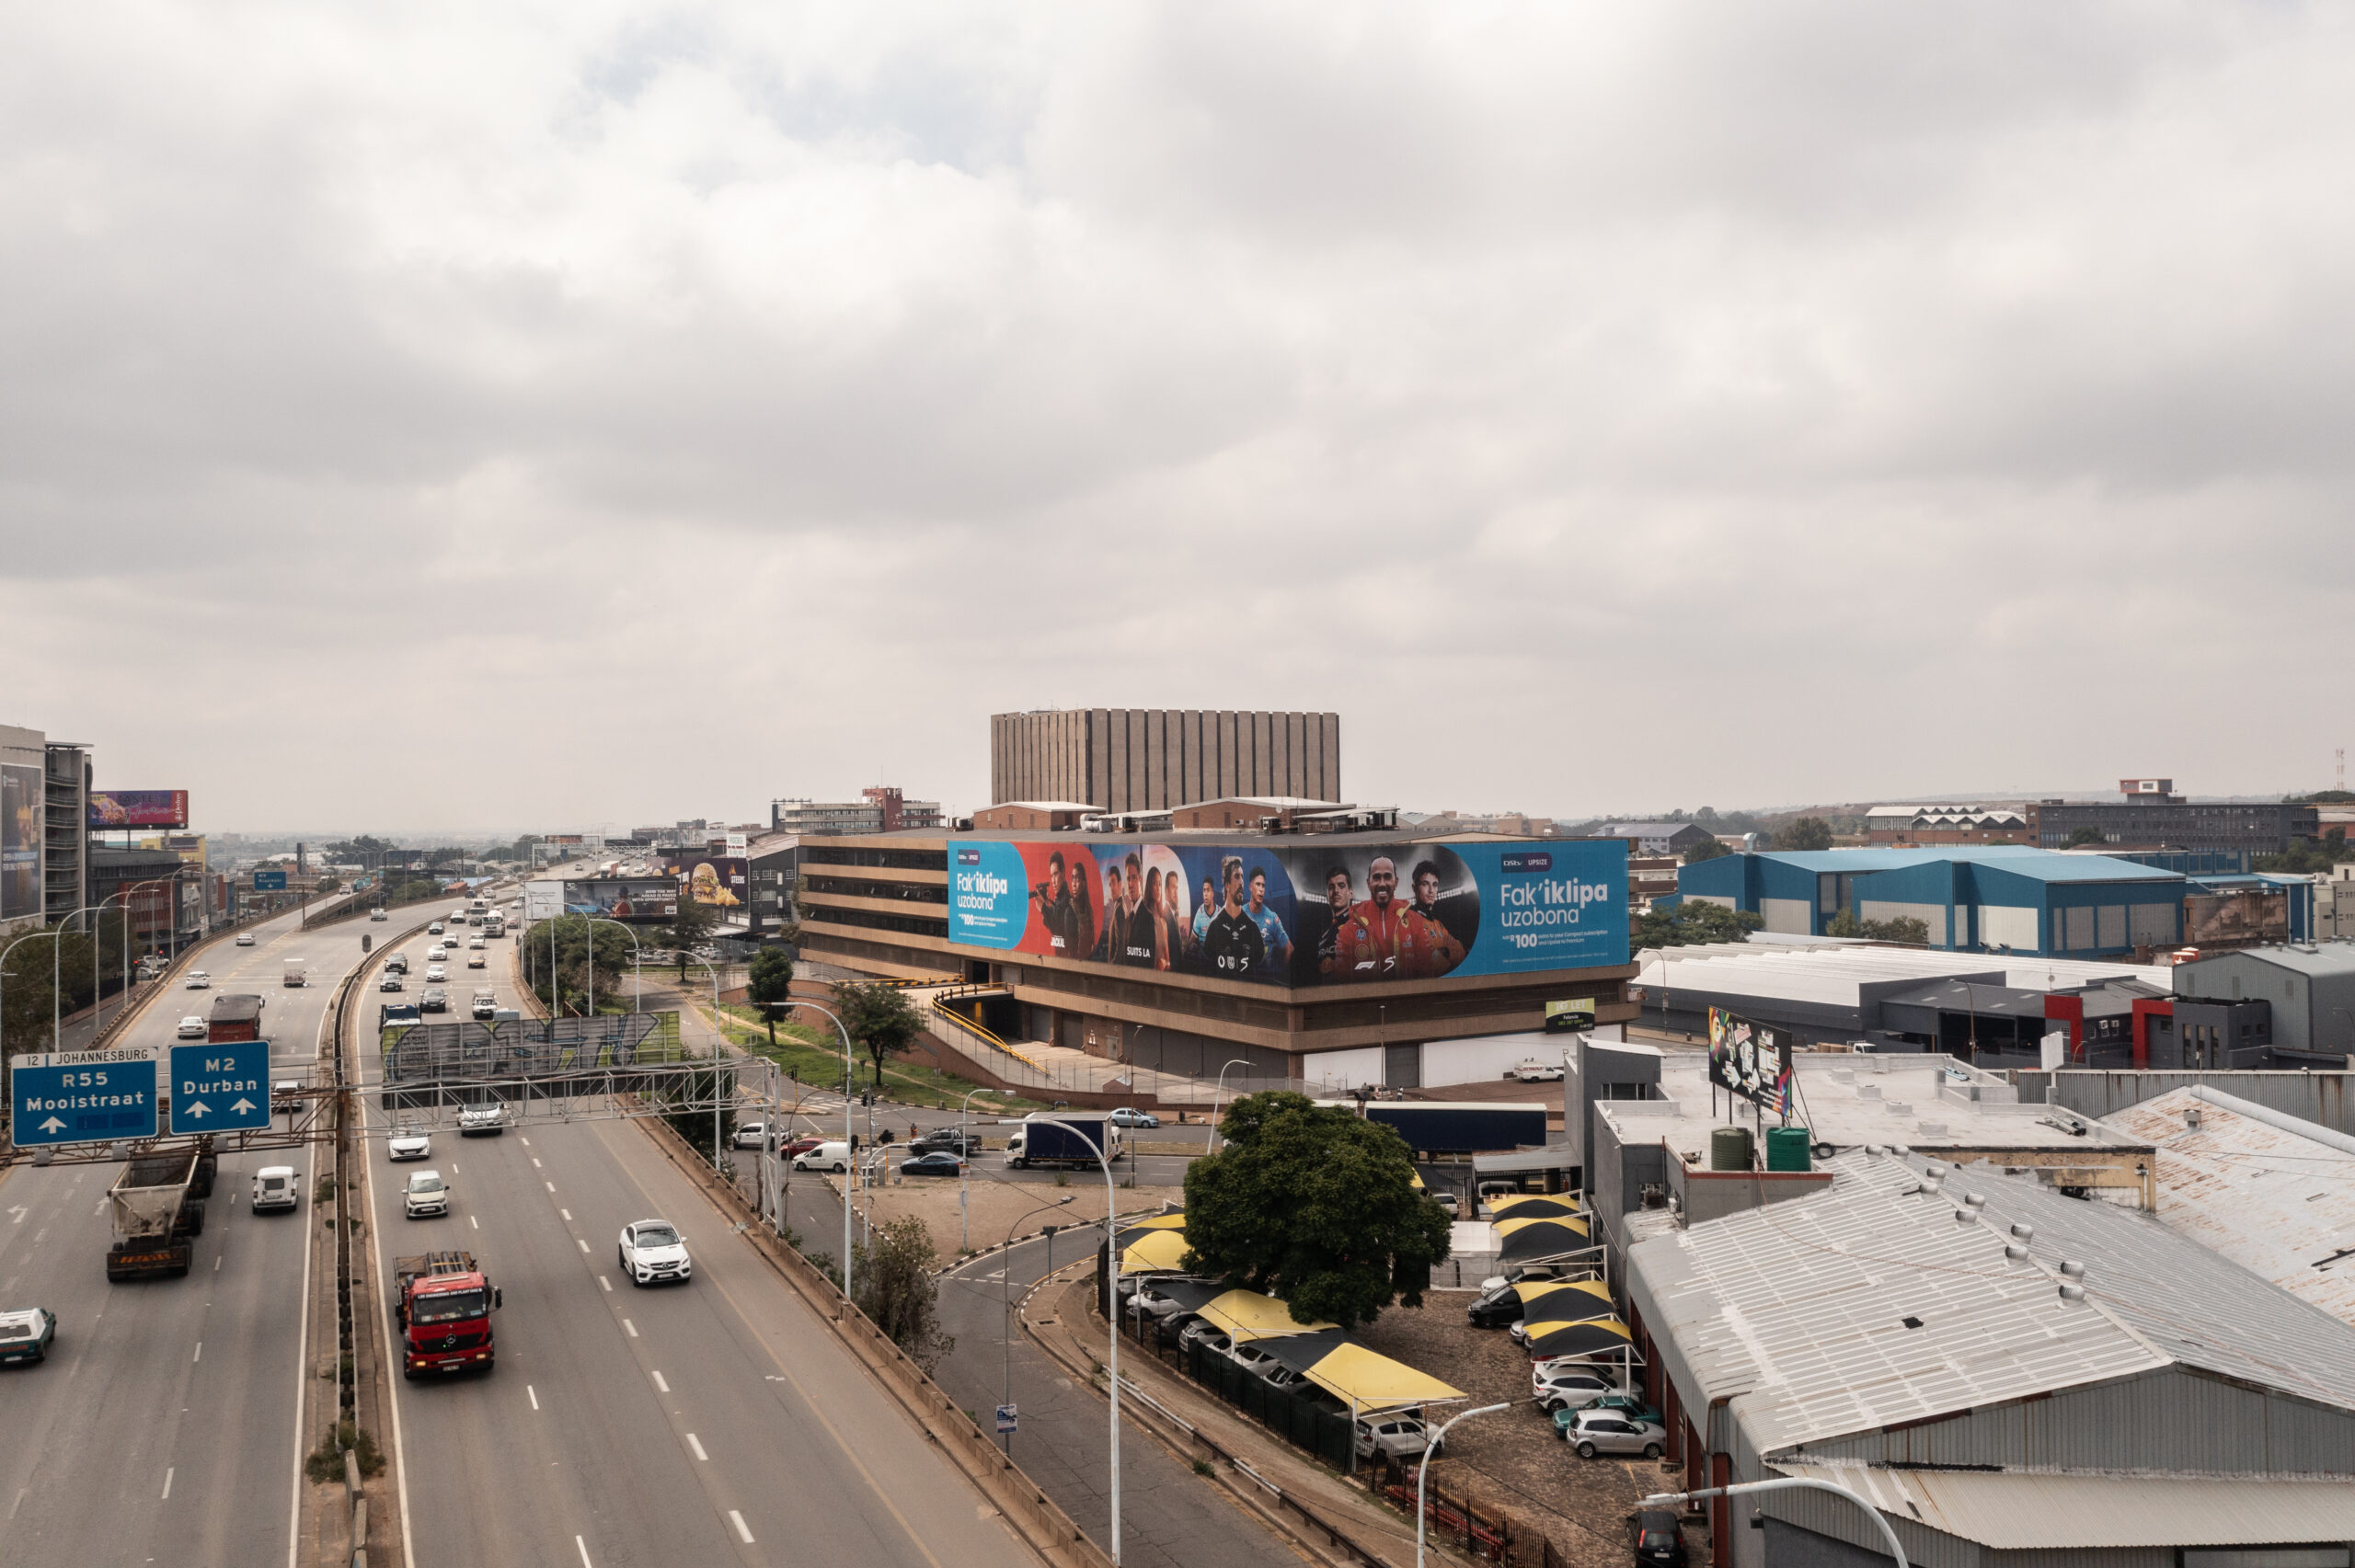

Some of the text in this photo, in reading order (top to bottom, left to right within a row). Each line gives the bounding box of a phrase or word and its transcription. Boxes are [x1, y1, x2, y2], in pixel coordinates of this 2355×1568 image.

[1528, 858, 1548, 866] UPSIZE
[957, 871, 1008, 899] Fak'iklipa
[1500, 877, 1608, 909] Fak'iklipa
[957, 893, 994, 910] uzobona
[1501, 907, 1579, 927] uzobona
[1126, 946, 1151, 957] SUITS LA
[1570, 1001, 1585, 1010] LET
[27, 1049, 148, 1066] 12 JOHANNESBURG
[205, 1058, 236, 1072] M2
[63, 1071, 109, 1088] R55
[184, 1078, 258, 1095] Durban
[27, 1091, 144, 1112] Mooistraat
